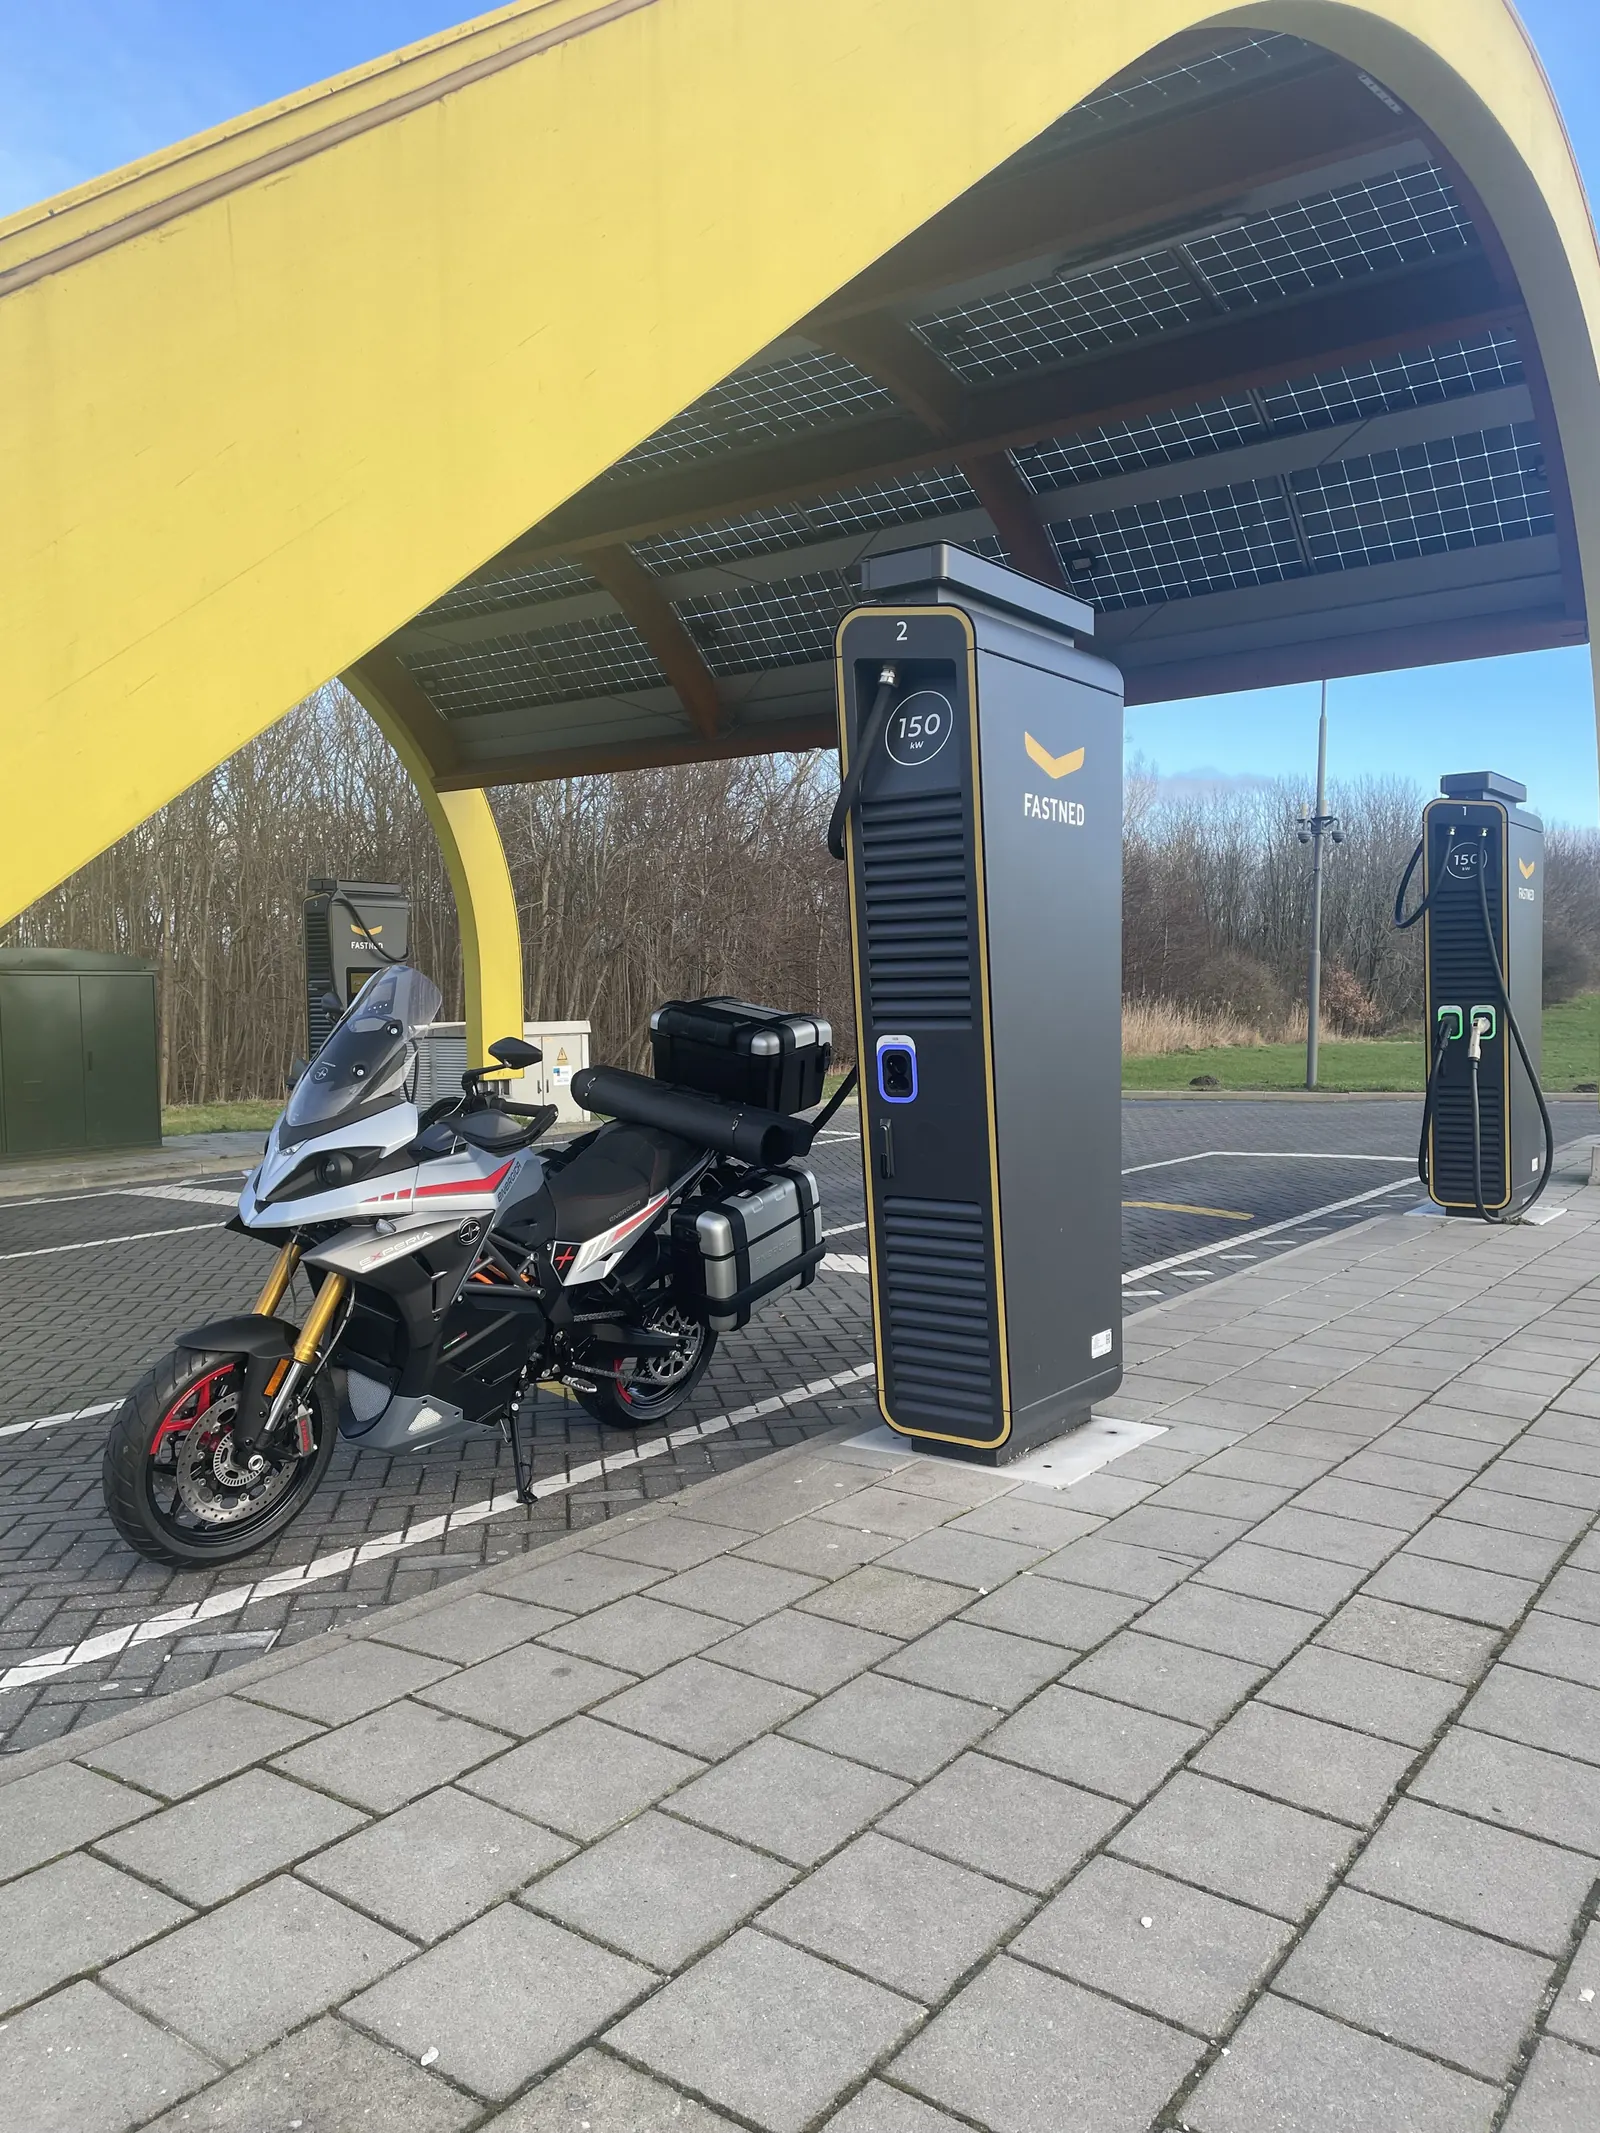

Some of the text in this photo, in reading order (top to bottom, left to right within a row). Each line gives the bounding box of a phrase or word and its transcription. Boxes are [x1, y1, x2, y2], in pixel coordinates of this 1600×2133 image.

[896, 621, 908, 641] 2
[899, 713, 941, 739] 150
[909, 740, 924, 750] kW
[1024, 792, 1085, 826] FASTNED
[1462, 806, 1468, 816] 1
